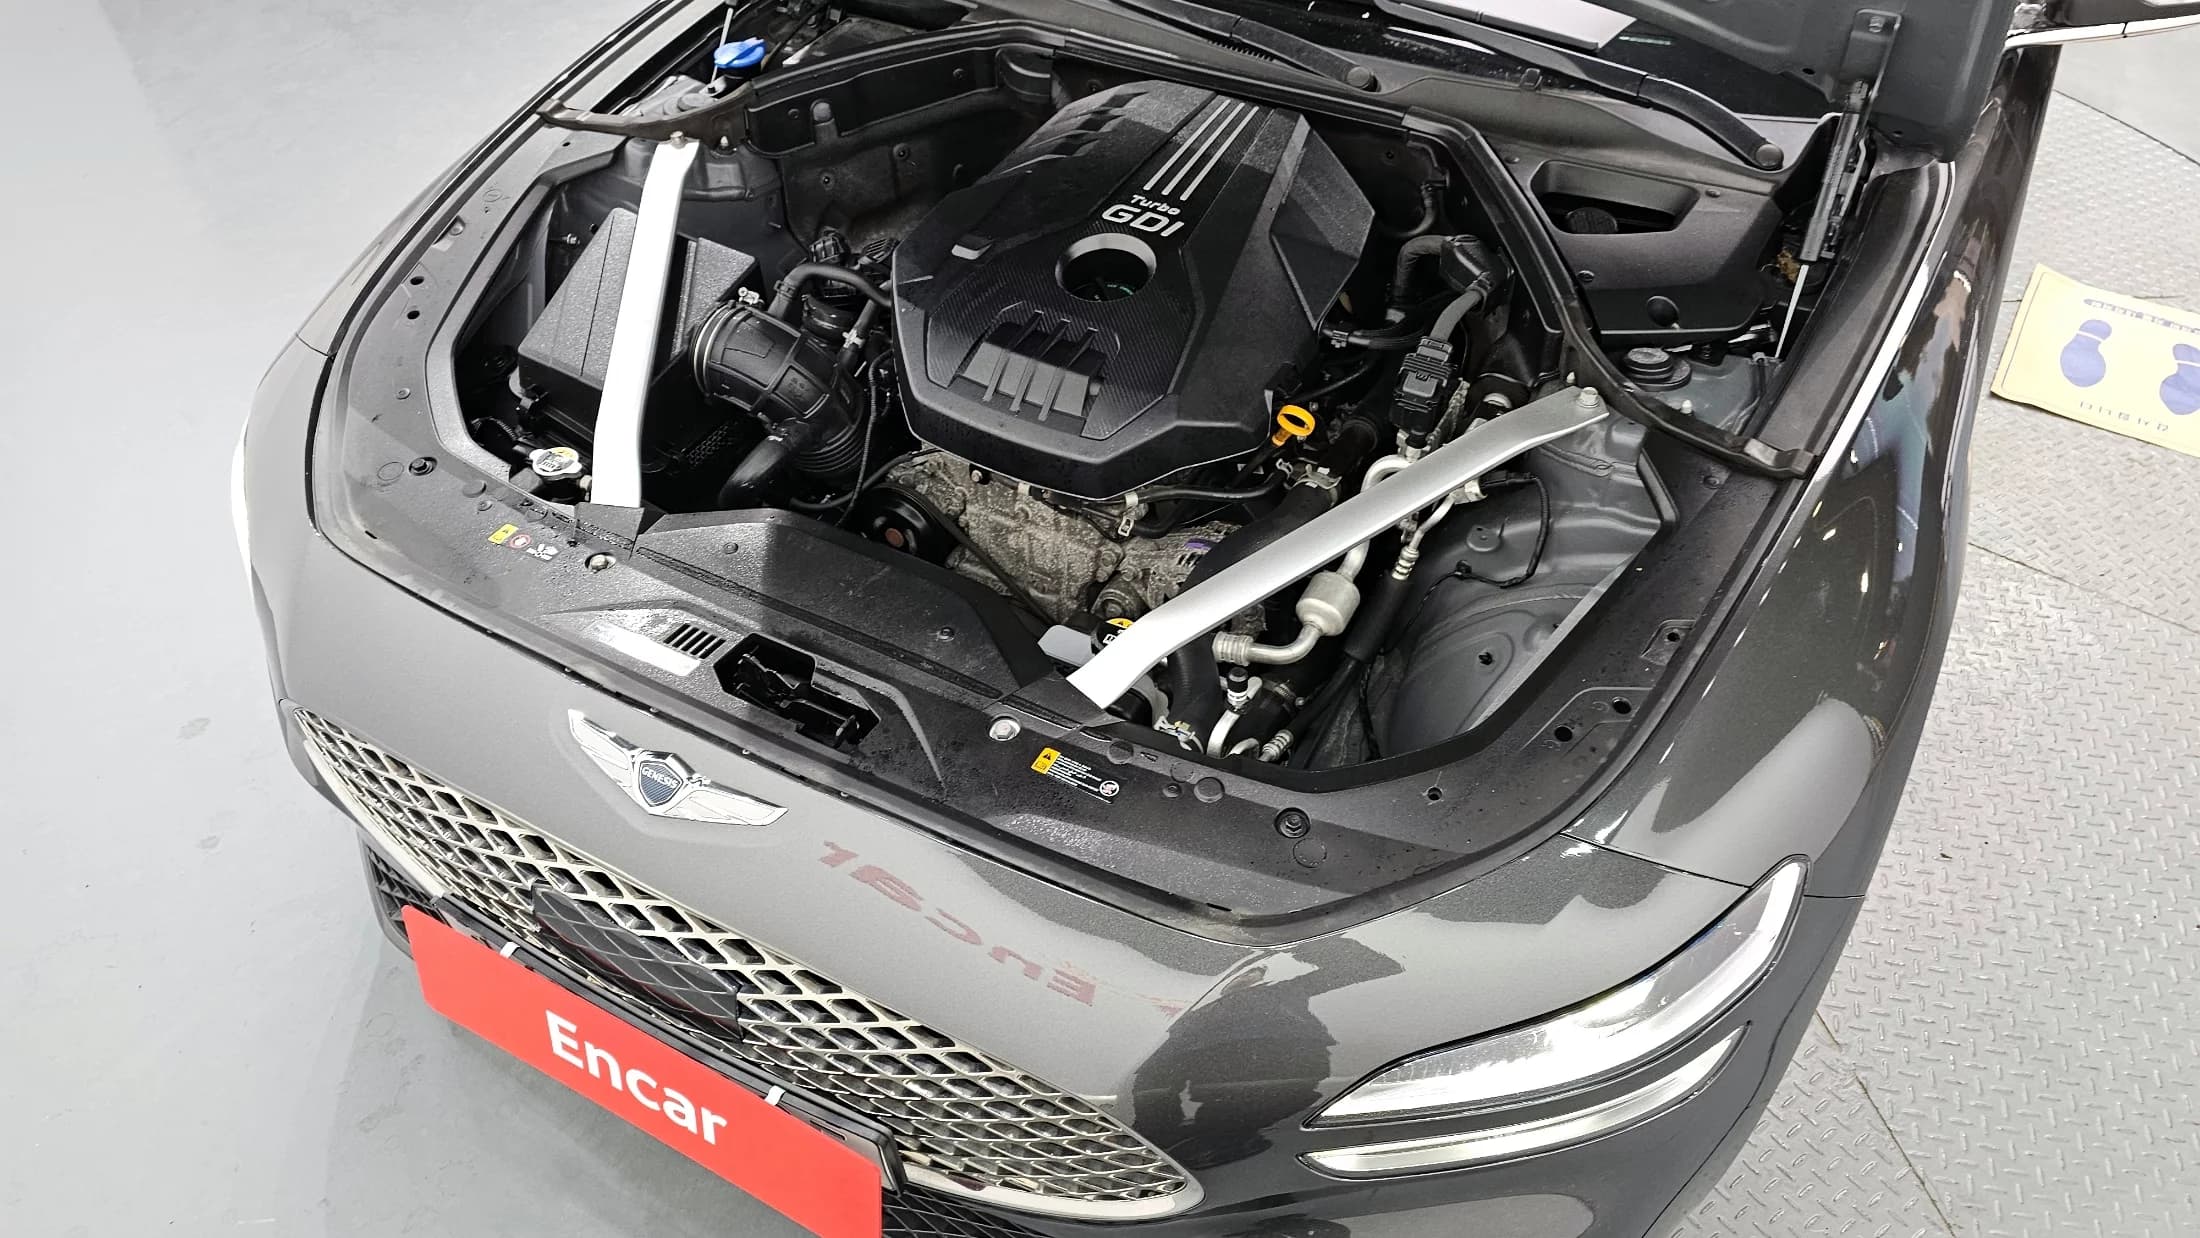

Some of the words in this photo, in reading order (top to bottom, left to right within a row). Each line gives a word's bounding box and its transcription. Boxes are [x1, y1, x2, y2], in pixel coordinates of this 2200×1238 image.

[1131, 194, 1181, 215] Turbo
[1101, 204, 1185, 237] GDI
[641, 766, 680, 789] GENESIS
[545, 1009, 728, 1145] Encar
